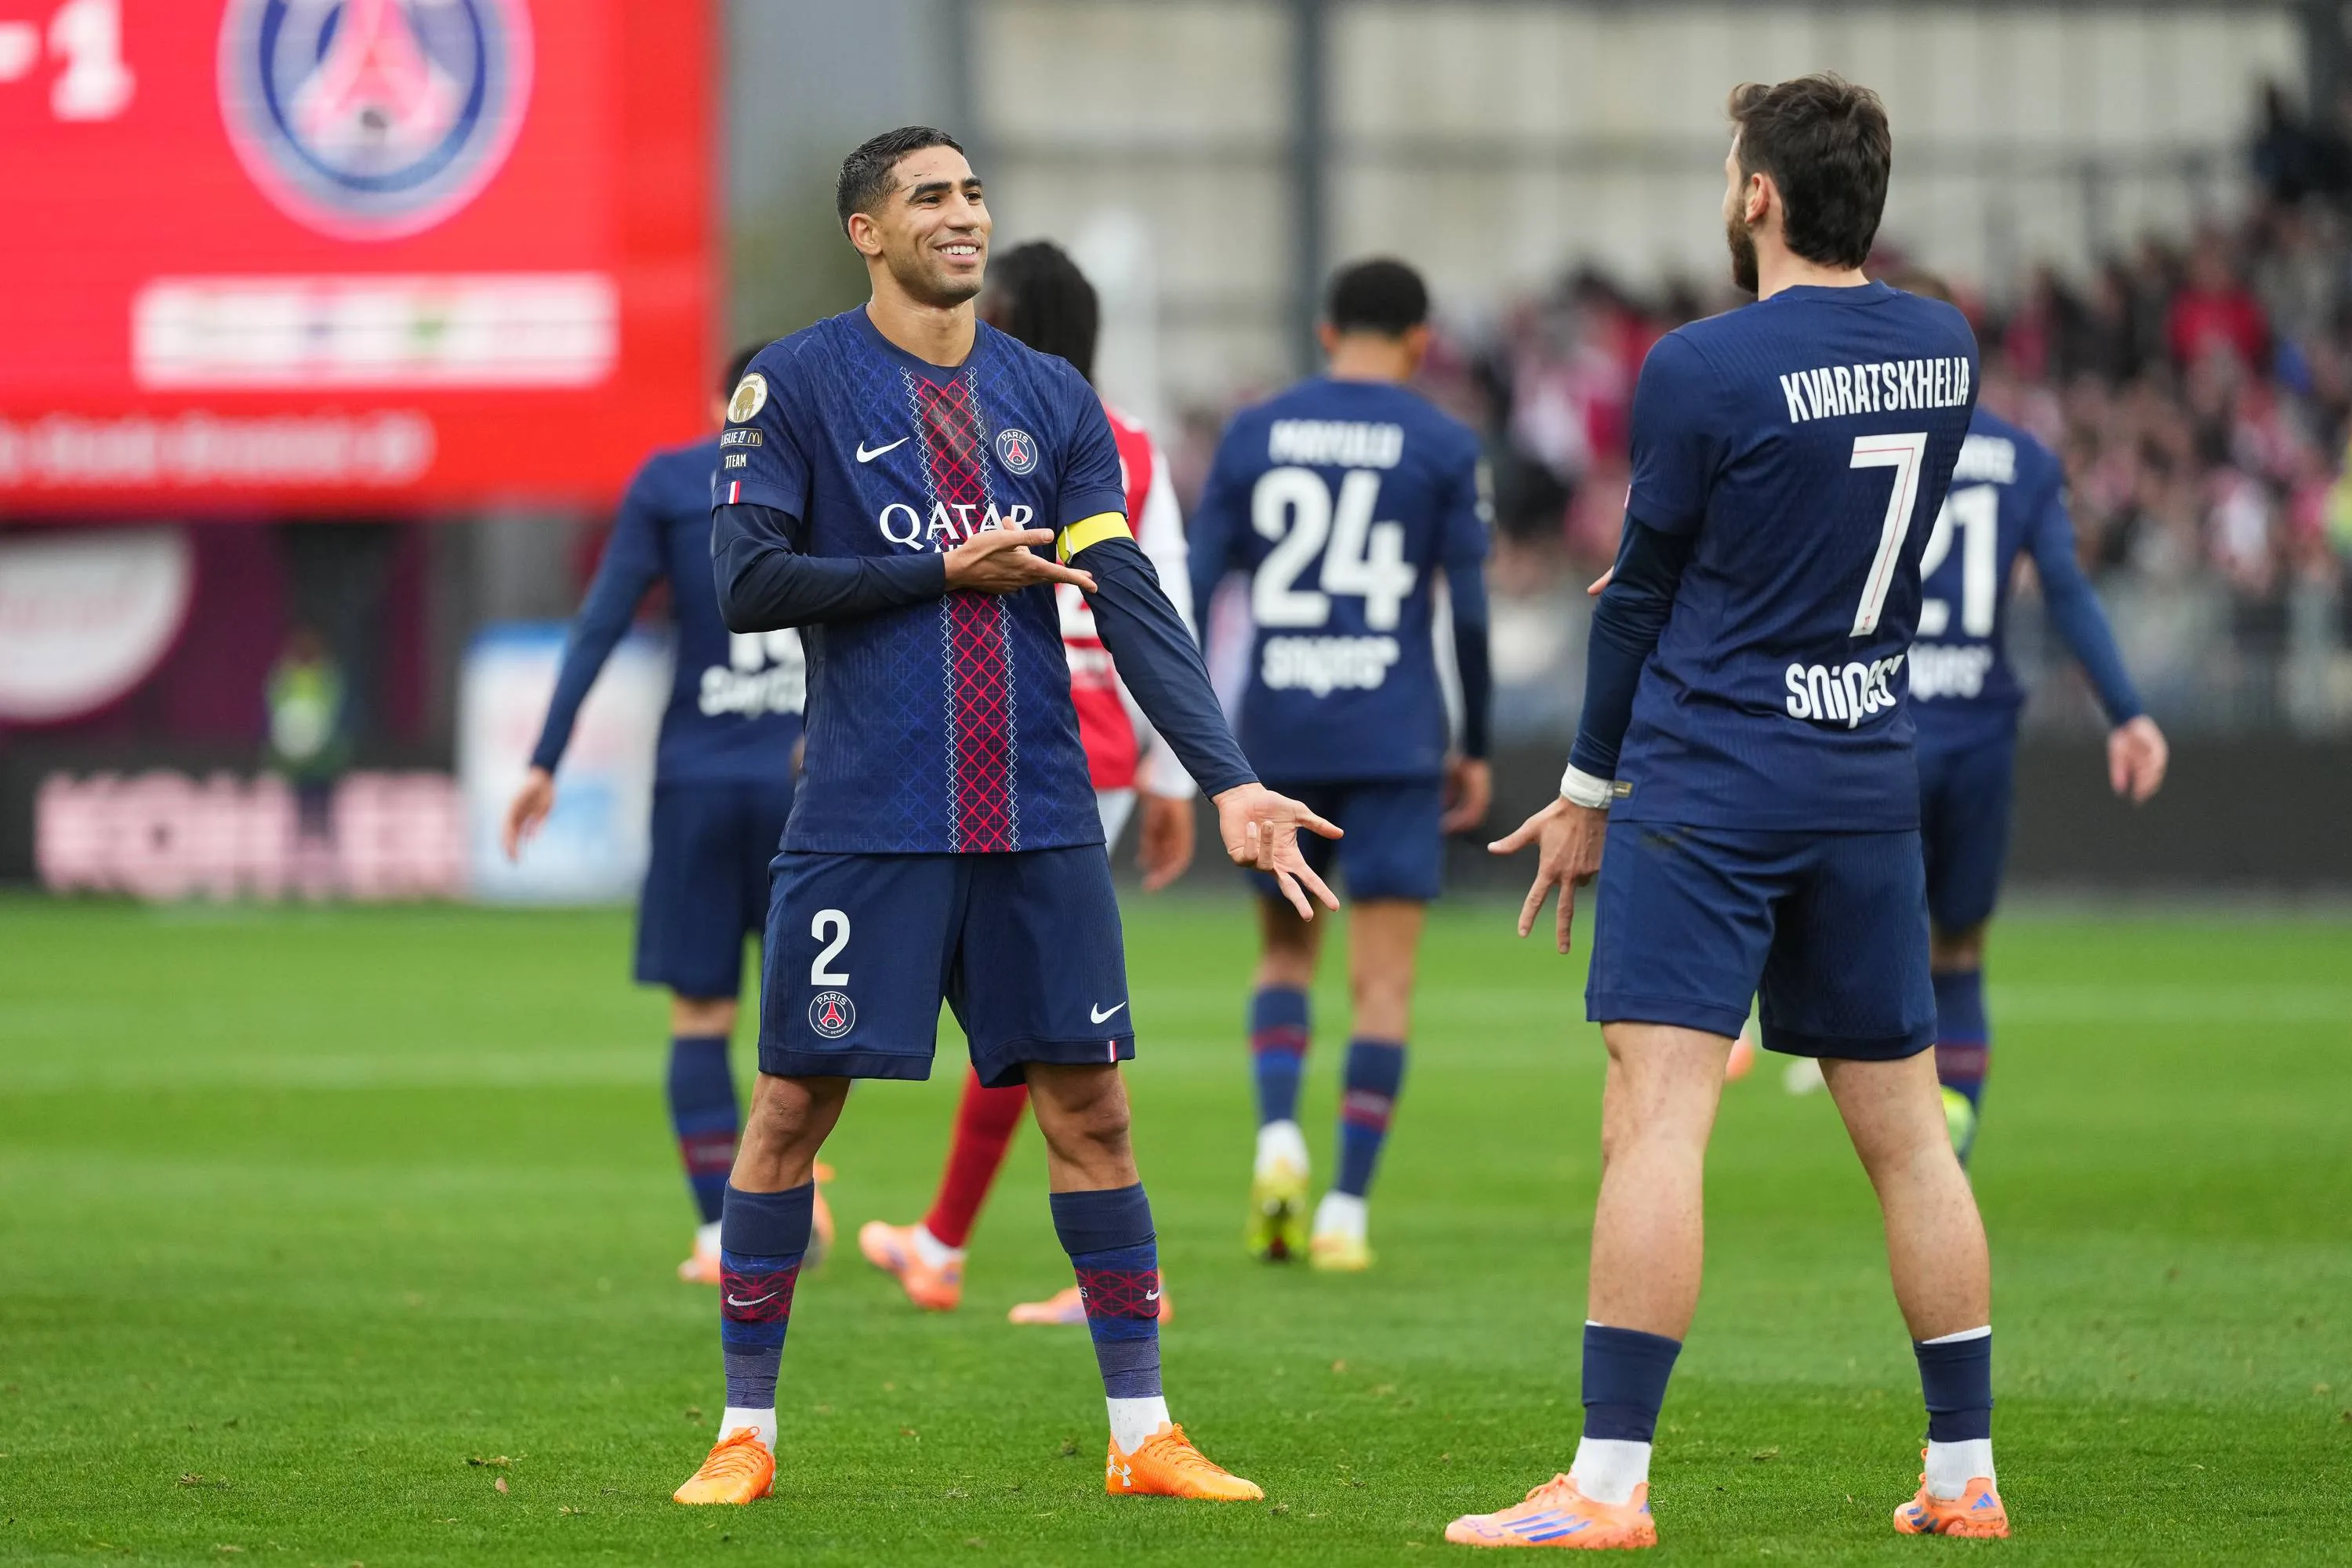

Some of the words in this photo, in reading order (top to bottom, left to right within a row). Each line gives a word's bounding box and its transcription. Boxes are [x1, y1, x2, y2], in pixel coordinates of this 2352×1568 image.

[1779, 357, 1969, 423] KVARATSKHELIA
[1001, 431, 1029, 444] PARIS
[1252, 466, 1417, 631] 24
[1849, 432, 1929, 637] 7
[811, 909, 851, 986] 2
[816, 993, 848, 1005] PARIS
